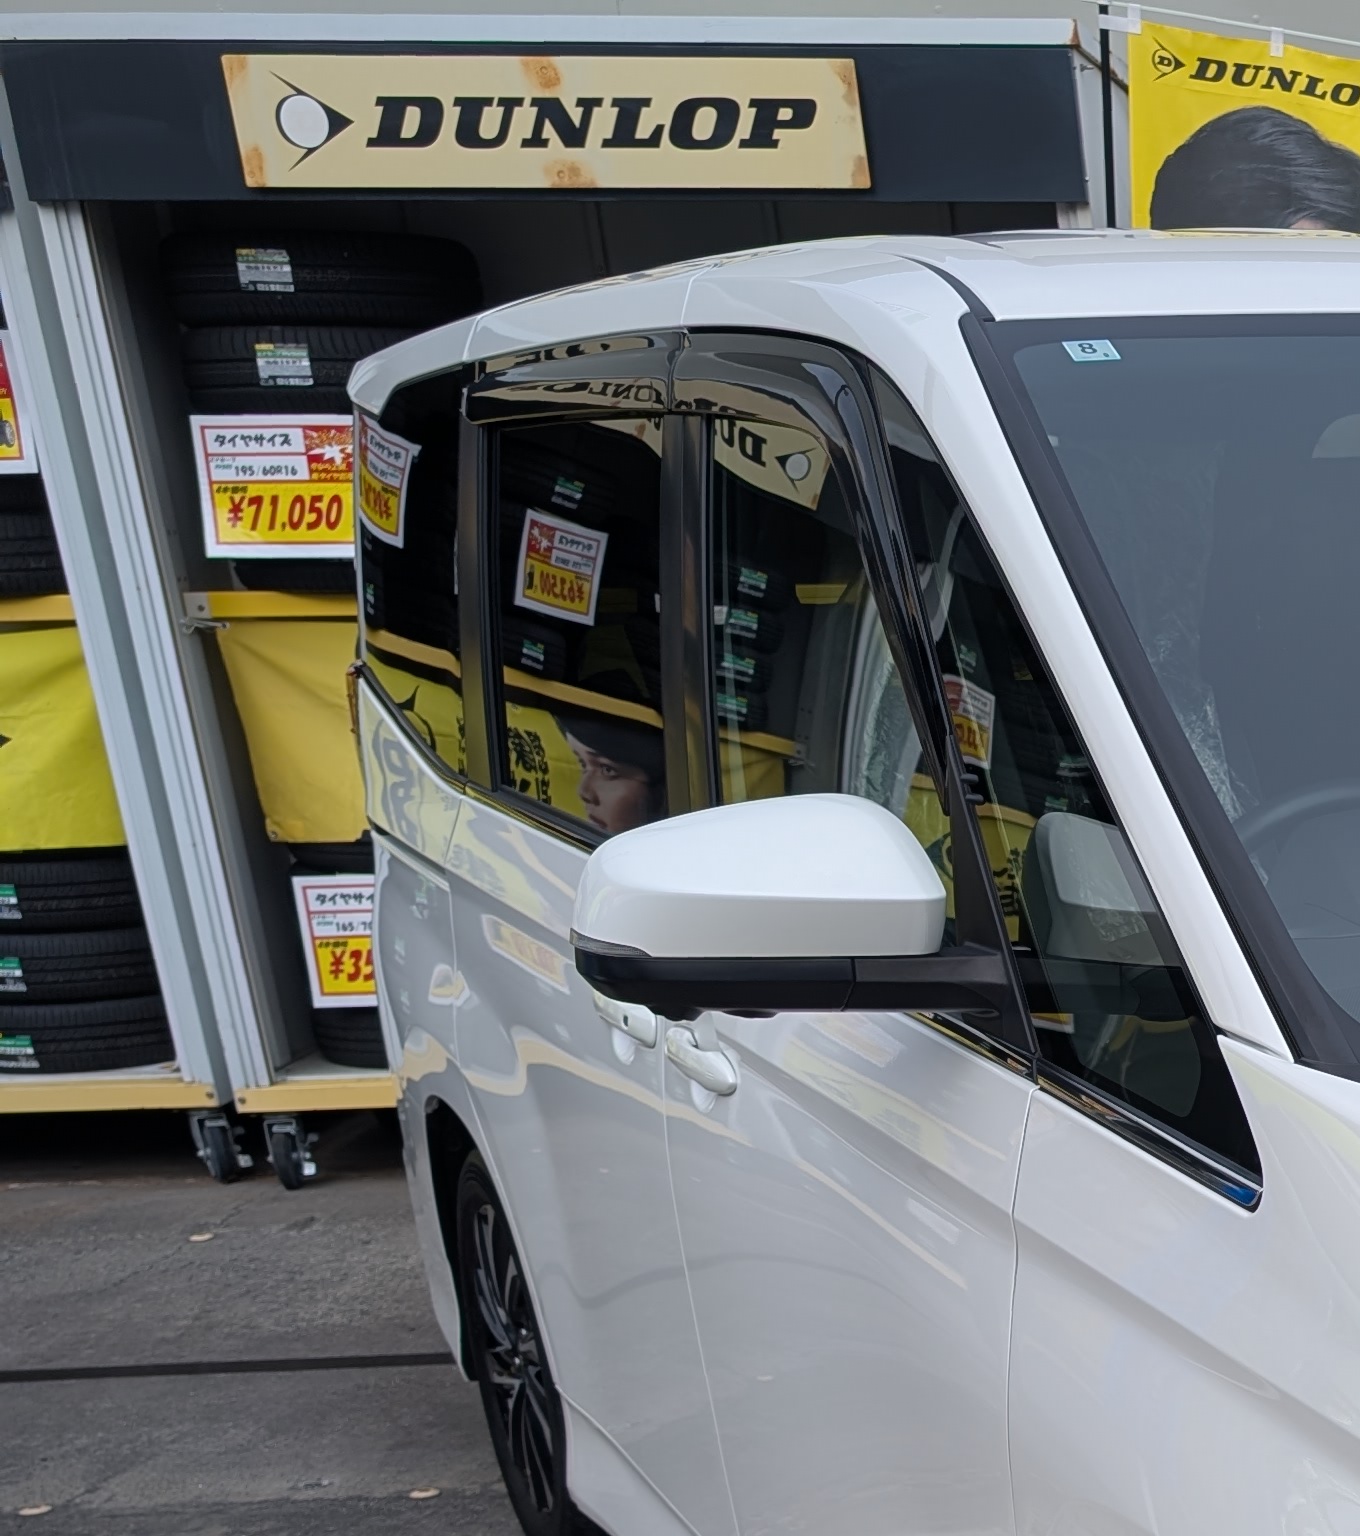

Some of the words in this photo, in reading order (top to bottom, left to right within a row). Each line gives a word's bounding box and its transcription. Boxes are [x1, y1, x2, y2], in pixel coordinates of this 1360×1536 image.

[365, 95, 818, 151] DUNLOP
[1077, 342, 1098, 355] 8
[213, 432, 293, 448] タイヤサイズ
[234, 464, 298, 477] 195/60R16
[226, 494, 344, 532] ¥71,050
